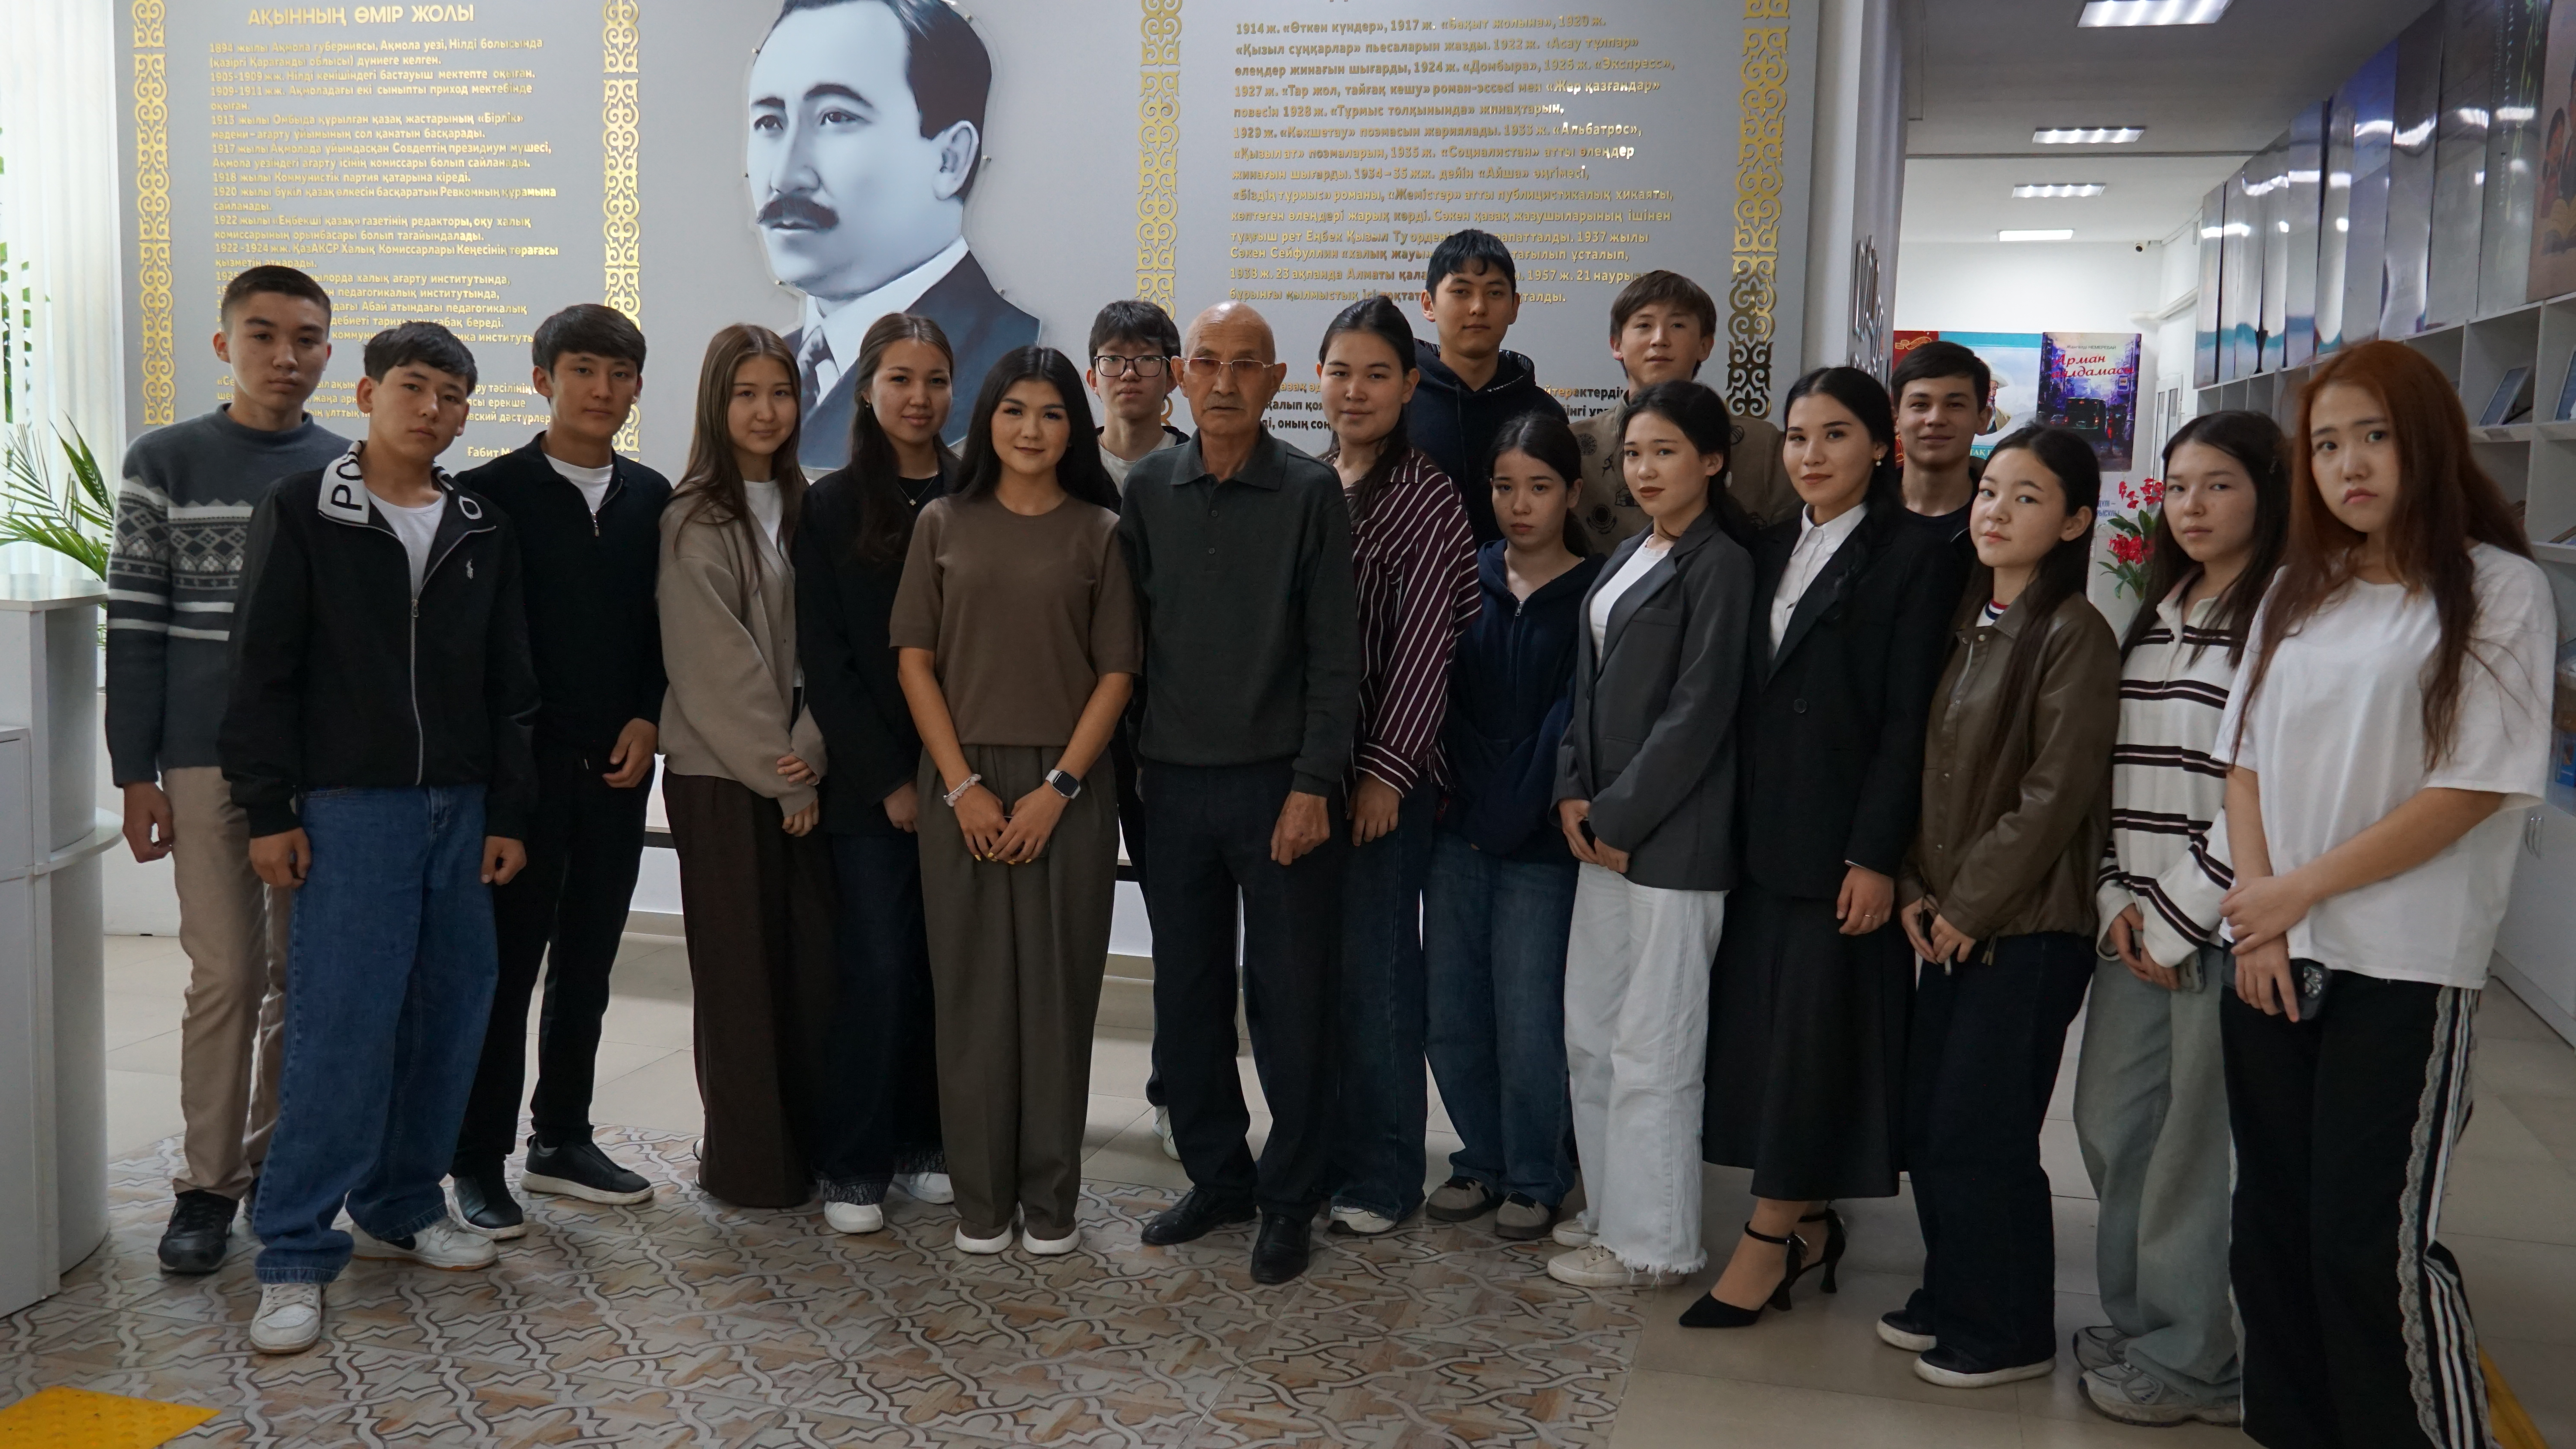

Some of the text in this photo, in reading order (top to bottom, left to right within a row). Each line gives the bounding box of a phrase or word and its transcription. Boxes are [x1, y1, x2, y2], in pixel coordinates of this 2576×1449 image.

[248, 4, 475, 28] АҚЫННЫҢ ӨМІР ЖОЛЫ
[1282, 20, 1328, 32] «Өткен
[1441, 17, 1488, 30] «Бақыт
[1235, 43, 1284, 56] «Қызыл
[1444, 41, 1490, 51] жазды.
[1234, 66, 1285, 77] өлеңдер
[1290, 65, 1345, 74] жинағын
[1281, 84, 1308, 98] «Тар
[1345, 82, 1385, 95] тайғақ
[1518, 83, 1542, 92] мен
[1546, 79, 1582, 95] «Жер
[1233, 108, 1279, 118] повесін
[1330, 103, 1383, 118] «Тұрмыс
[1360, 127, 1420, 136] поэмасын
[1424, 126, 1501, 139] жариялады.
[1233, 147, 1282, 161] «Қызыл
[1544, 146, 1574, 158] атты
[1579, 146, 1634, 159] өлеңдер
[1231, 170, 1286, 179] жинағын
[1290, 170, 1350, 182] шығарды.
[1438, 166, 1473, 180] дейін
[1231, 188, 1276, 202] «Біздің
[1464, 190, 1494, 200] атты
[1497, 188, 1612, 202] публицистикалық
[1230, 208, 1672, 224] көптеген өлеңдері жарық көрді. Сәкен қазақ жазушыларының ішінен
[1230, 229, 1407, 245] тұңғыш рет Еңбек Қызыл Ту
[1610, 233, 1649, 243] жылы
[1229, 246, 1266, 258] Сәкен
[1270, 246, 1338, 261] Сейфуллин
[1341, 249, 1387, 259] «халық
[1292, 270, 1342, 281] ақпанда
[1346, 267, 1394, 279] Алматы
[1229, 287, 1282, 300] бұрынғы
[1285, 290, 1358, 302] қылмыстық
[2051, 354, 2105, 367] Арман
[2051, 366, 2134, 379] аялдамасы
[1278, 382, 1307, 393] азақ
[1278, 419, 1309, 430] оның
